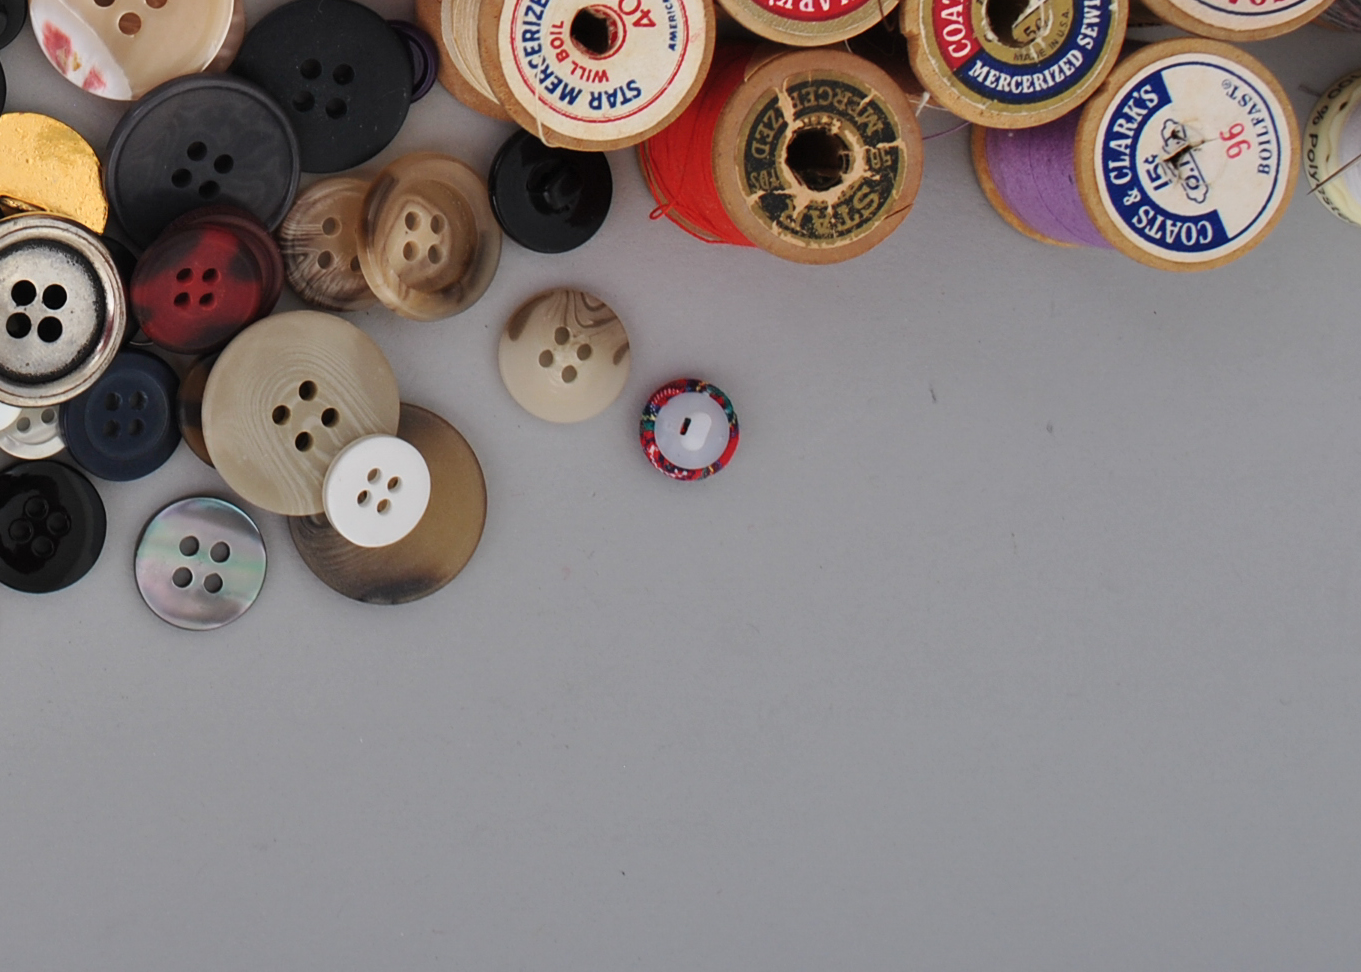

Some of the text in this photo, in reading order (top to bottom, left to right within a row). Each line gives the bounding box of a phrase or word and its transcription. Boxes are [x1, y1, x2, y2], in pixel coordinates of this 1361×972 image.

[549, 20, 610, 84] WILL BOIL
[1047, 38, 1060, 50] IN
[967, 48, 1085, 95] MERCERIZED
[588, 79, 642, 111] STAR
[1108, 84, 1159, 185] CLARK'S
[1312, 104, 1329, 126] %
[869, 148, 893, 169] 50
[1219, 121, 1252, 160] 96
[1142, 152, 1174, 192] 15¢
[1122, 186, 1142, 206] &
[1131, 204, 1214, 246] COATS
